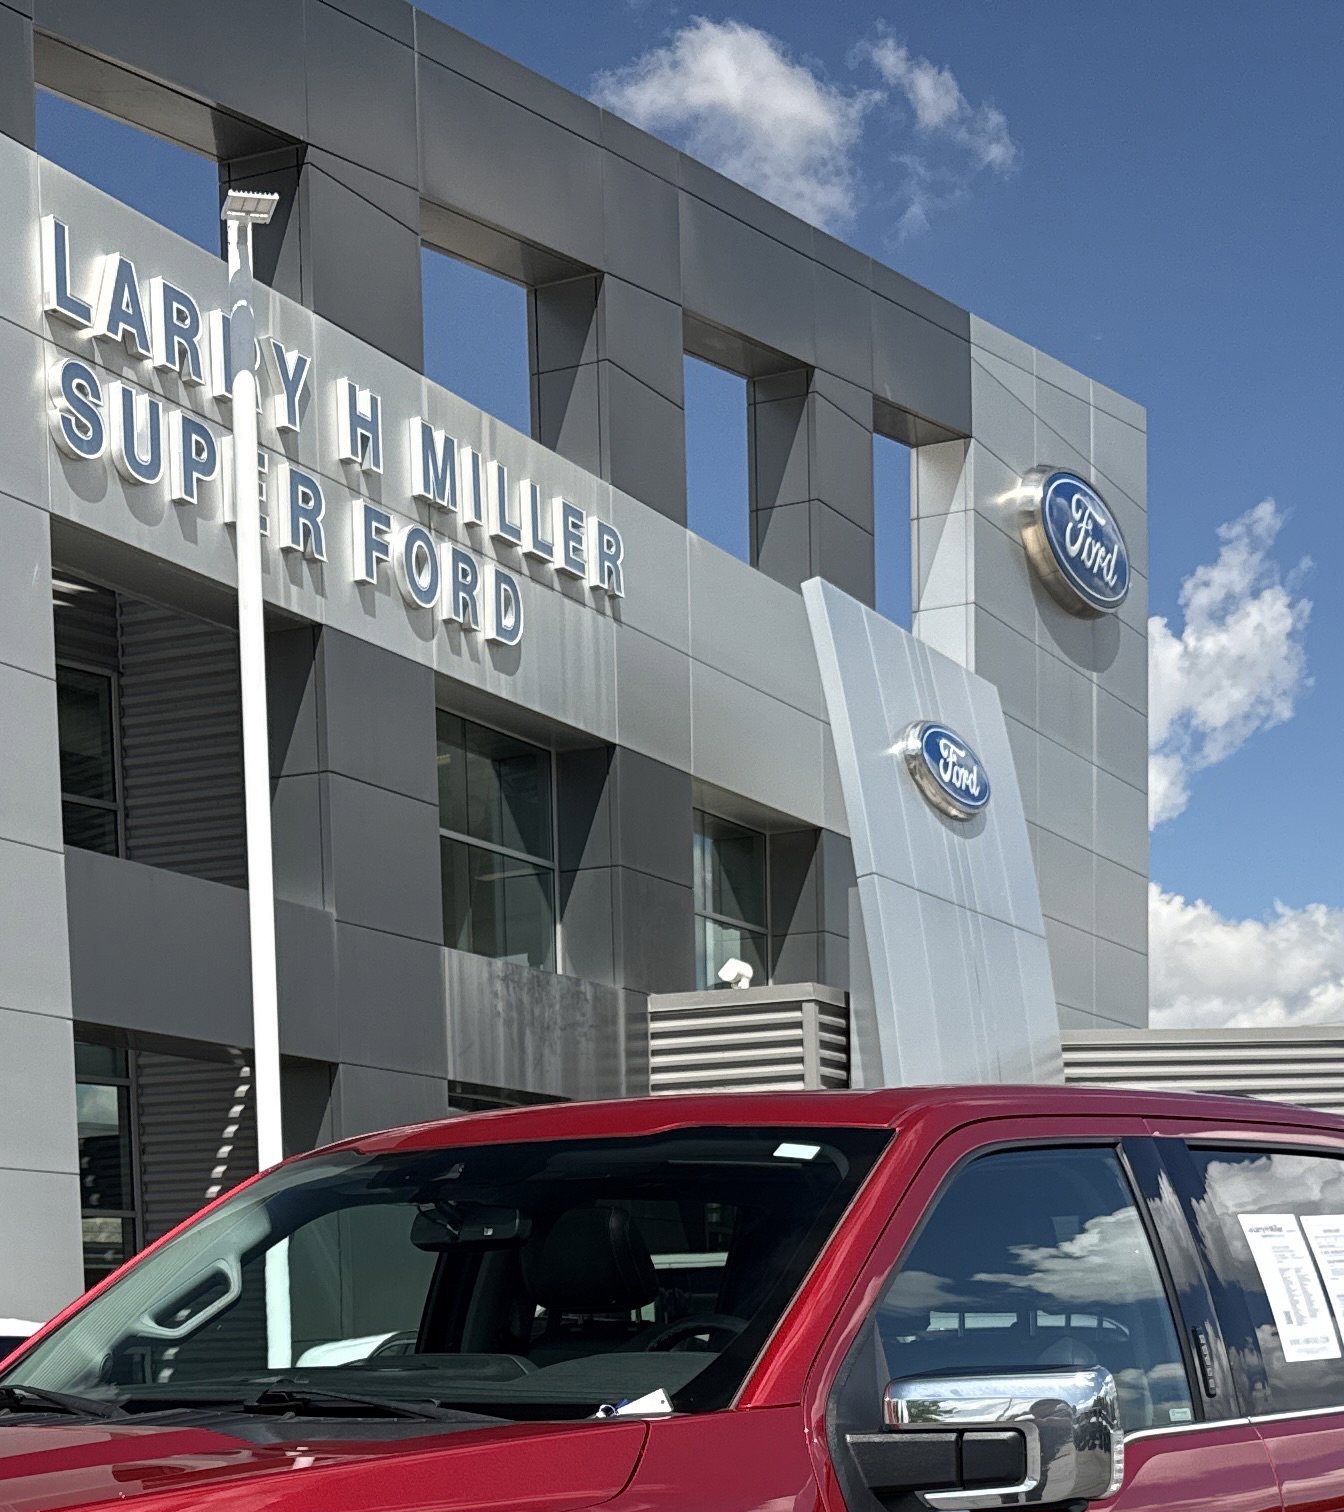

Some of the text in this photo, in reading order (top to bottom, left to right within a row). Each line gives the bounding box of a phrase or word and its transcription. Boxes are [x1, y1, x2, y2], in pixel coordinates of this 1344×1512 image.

[337, 377, 383, 474] H
[410, 415, 626, 598] MILLER
[1065, 492, 1117, 587] Ford
[353, 497, 524, 646] FORD
[938, 737, 981, 797] Ford
